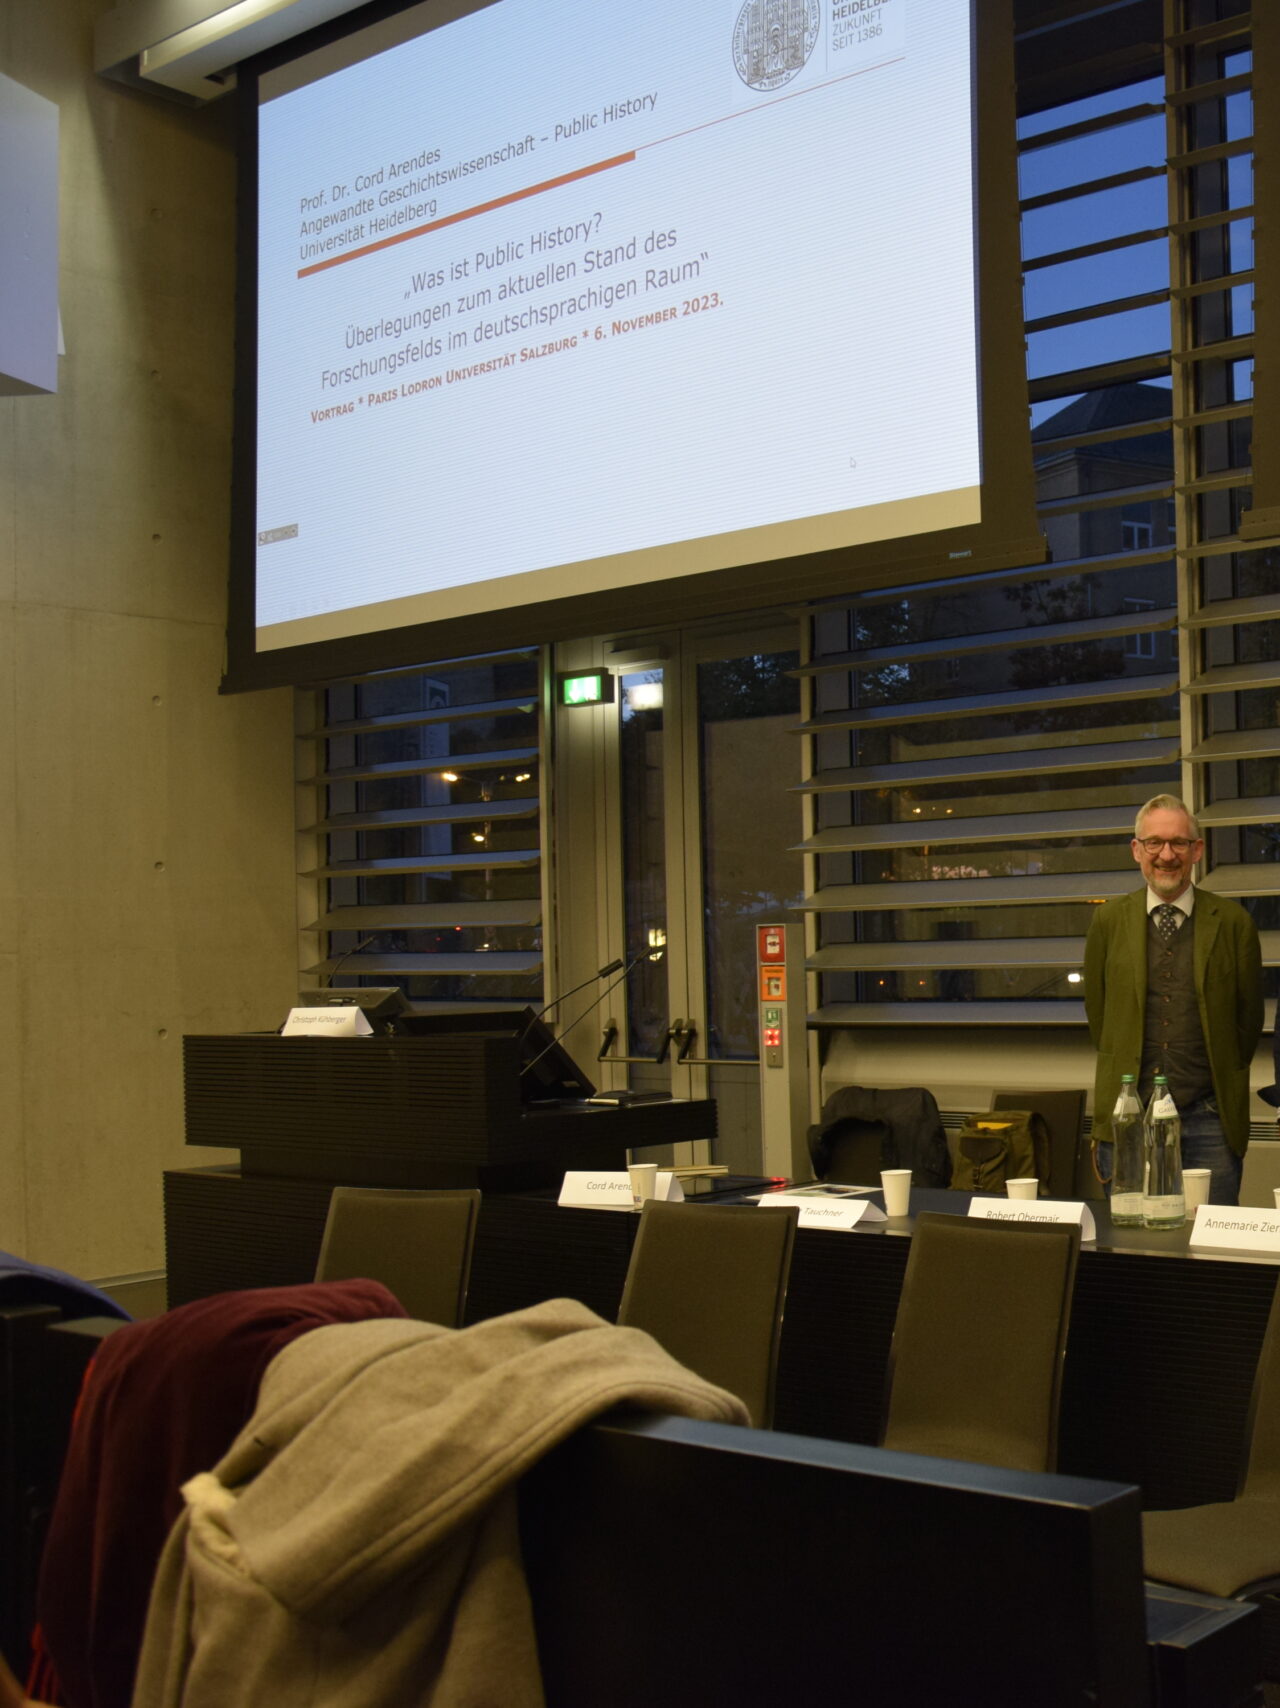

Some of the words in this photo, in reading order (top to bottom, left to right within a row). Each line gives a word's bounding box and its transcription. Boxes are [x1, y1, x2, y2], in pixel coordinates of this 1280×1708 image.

[832, 8, 882, 37] ZUKUNFT
[832, 32, 854, 51] SEIT
[857, 24, 883, 43] 1386
[300, 198, 375, 238] Angewandte
[378, 134, 535, 208] Geschichtswissenschaft
[554, 113, 598, 142] Public
[603, 92, 658, 125] History
[300, 189, 328, 214] Prof.
[332, 184, 350, 202] Dr.
[355, 167, 384, 192] Cord
[389, 148, 441, 180] Arendes
[300, 223, 365, 260] Universität
[369, 199, 437, 236] Heidelberg
[450, 258, 470, 282] ist
[476, 241, 524, 272] Public
[530, 212, 603, 255] History?
[345, 302, 451, 350] Überlegungen
[457, 288, 491, 314] zum
[497, 261, 577, 301] aktuellen
[583, 236, 637, 274] Stand
[644, 229, 678, 255] des
[322, 337, 442, 390] Forschungsfelds
[448, 329, 468, 351] im
[473, 279, 637, 344] deutschsprachigen
[367, 388, 398, 407] PARIS
[401, 375, 443, 398] LODRON
[519, 335, 578, 363] SALZBURG
[594, 325, 607, 341] 6.
[611, 306, 678, 337] NOVEMBER
[682, 292, 724, 316] 2023.
[586, 1180, 606, 1191] Cord
[805, 1207, 844, 1218] Tauchner
[1205, 1218, 1259, 1232] Annemarie
